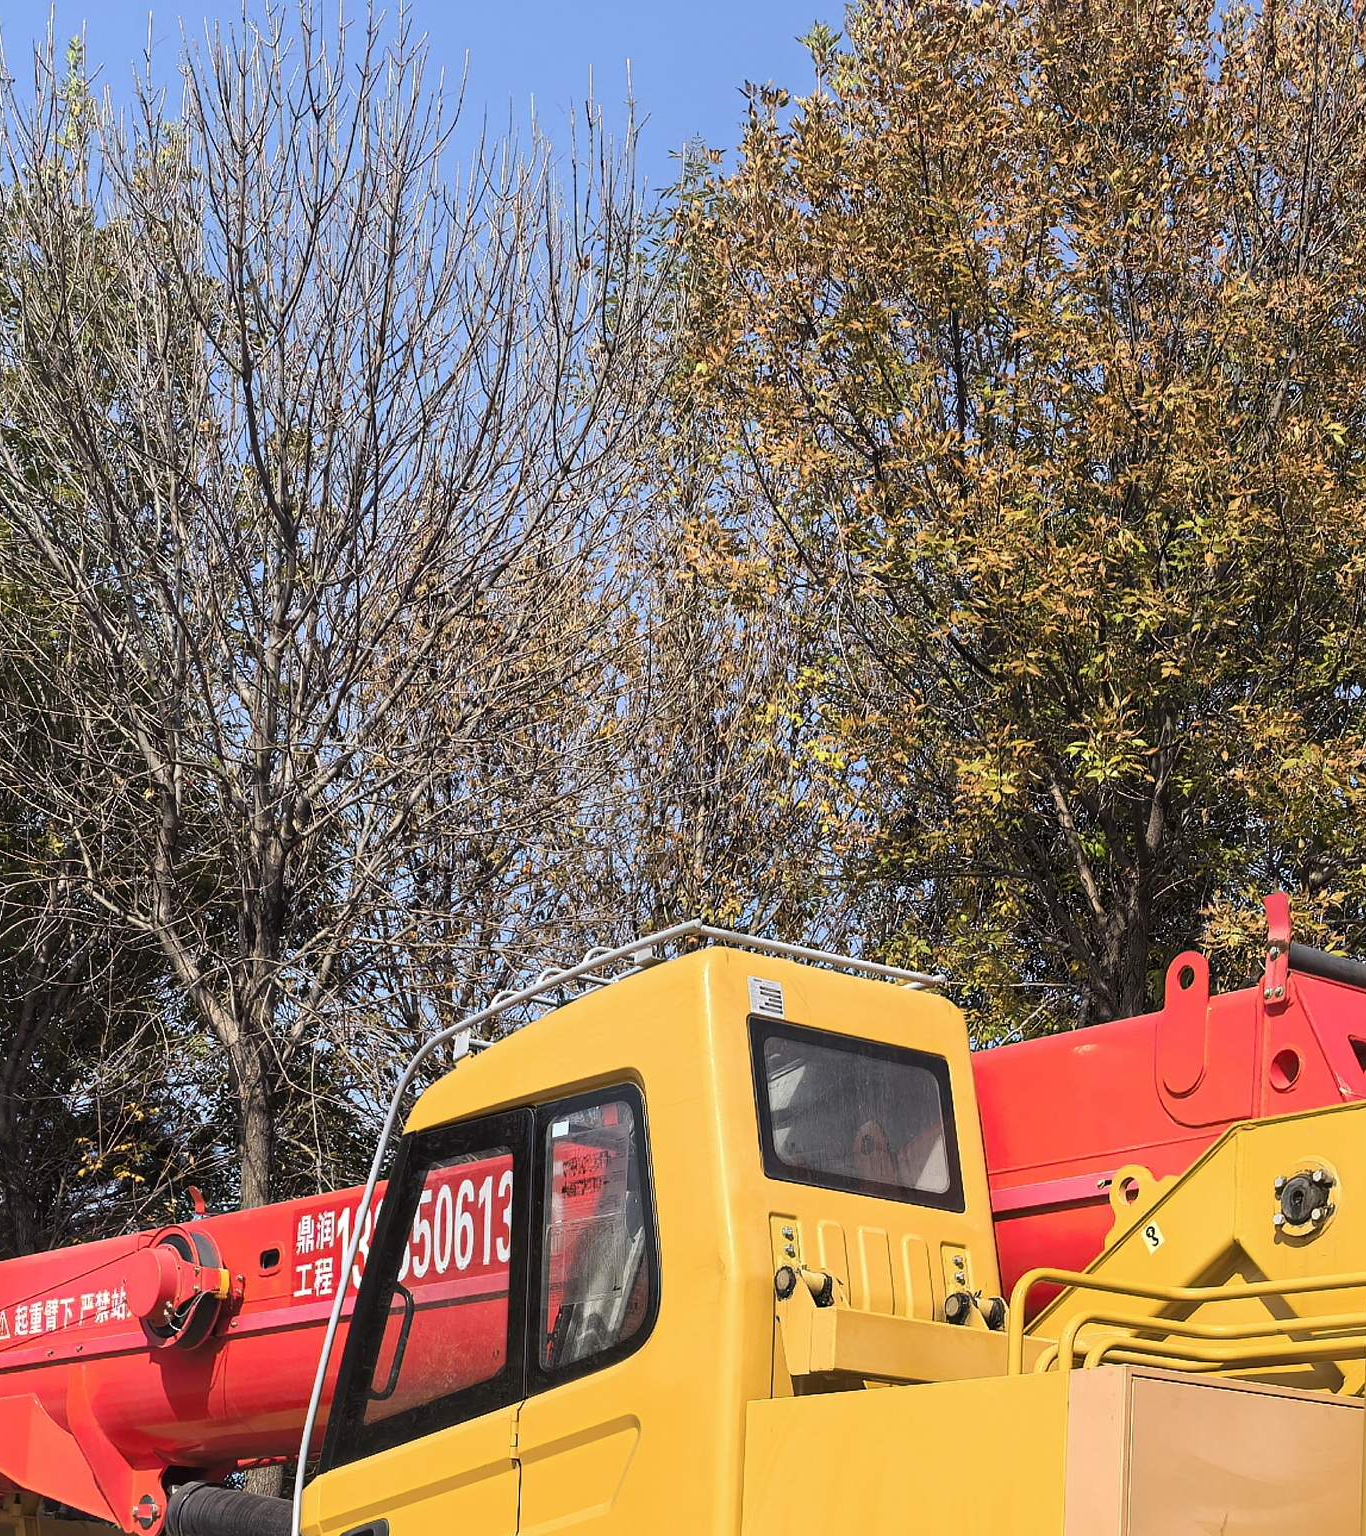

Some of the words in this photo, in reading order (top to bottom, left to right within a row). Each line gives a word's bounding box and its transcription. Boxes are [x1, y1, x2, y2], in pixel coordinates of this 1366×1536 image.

[296, 1209, 335, 1255] 鼎润
[293, 1256, 334, 1298] 工程
[14, 1297, 75, 1336] 起重臂下
